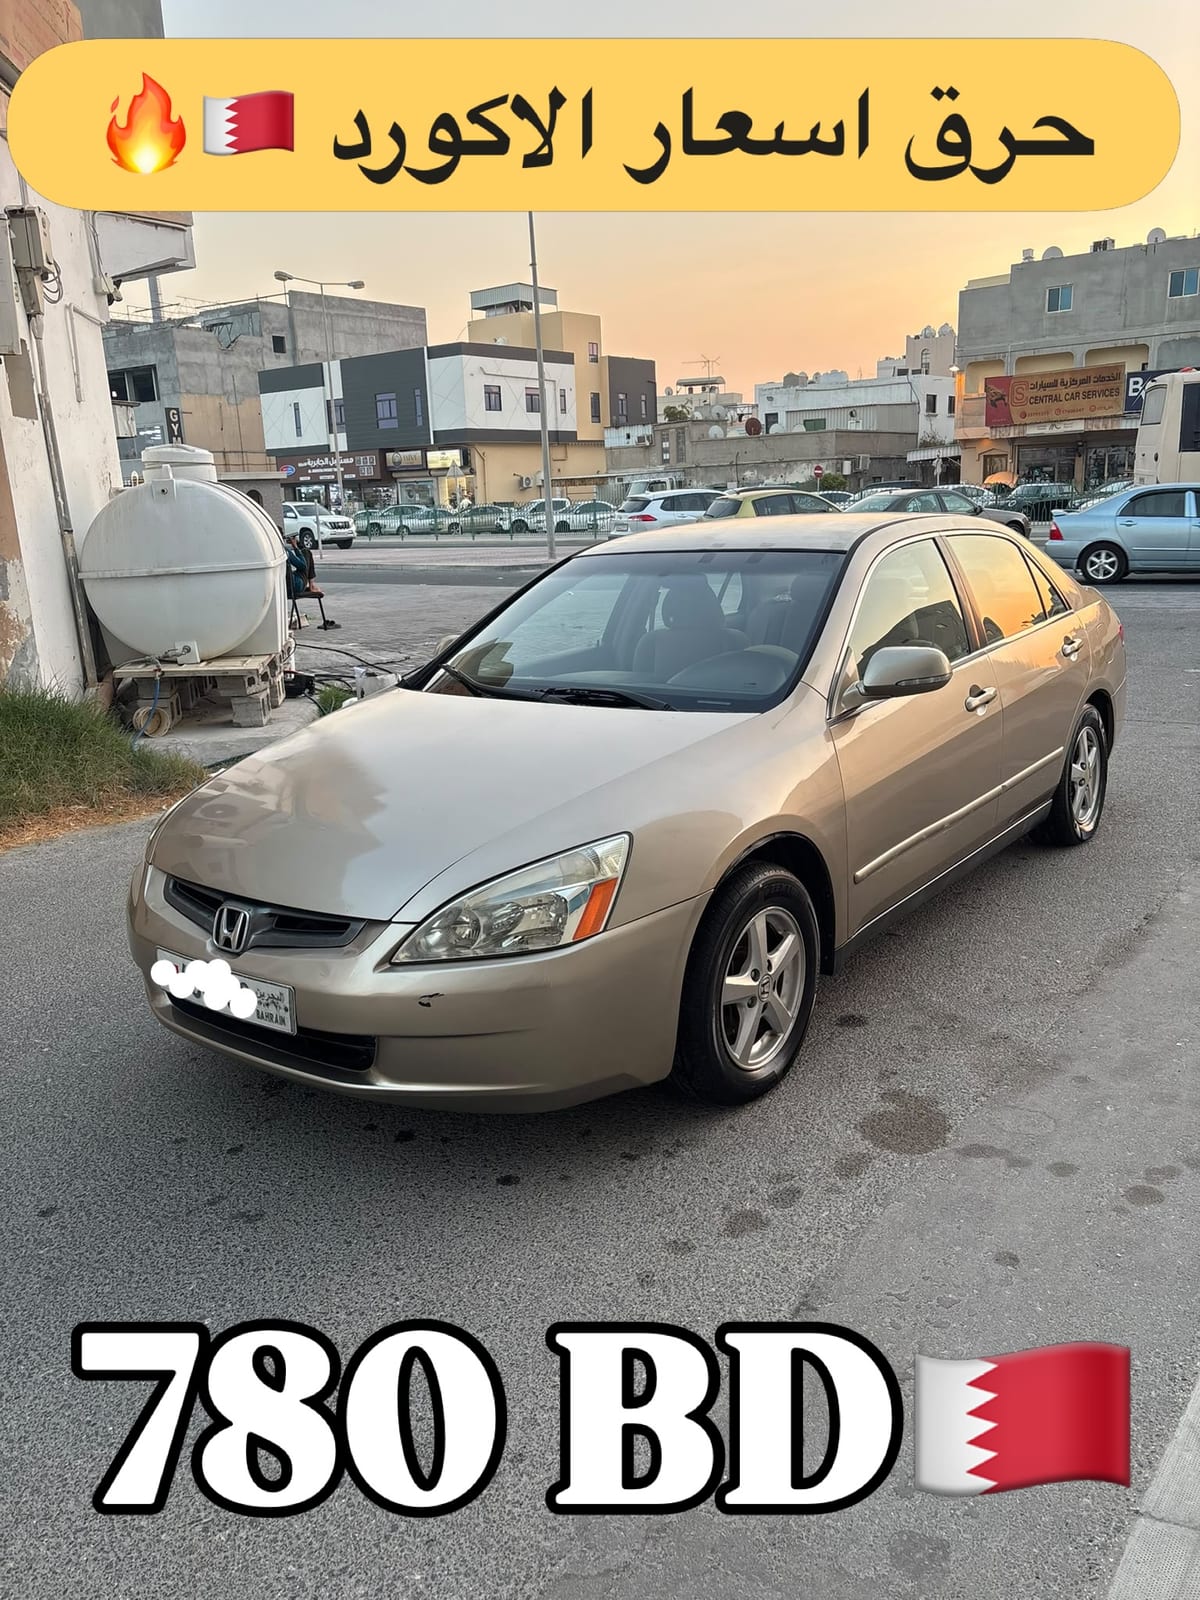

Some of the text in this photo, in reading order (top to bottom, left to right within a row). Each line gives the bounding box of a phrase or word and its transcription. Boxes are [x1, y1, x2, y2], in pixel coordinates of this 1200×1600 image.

[1060, 375, 1091, 389] المركزية
[1093, 373, 1120, 384] الخدمات
[1029, 388, 1120, 405] CENTRAL CAR SERVICES
[255, 987, 285, 1003] البحرين
[256, 1008, 287, 1026] BAHRAIN
